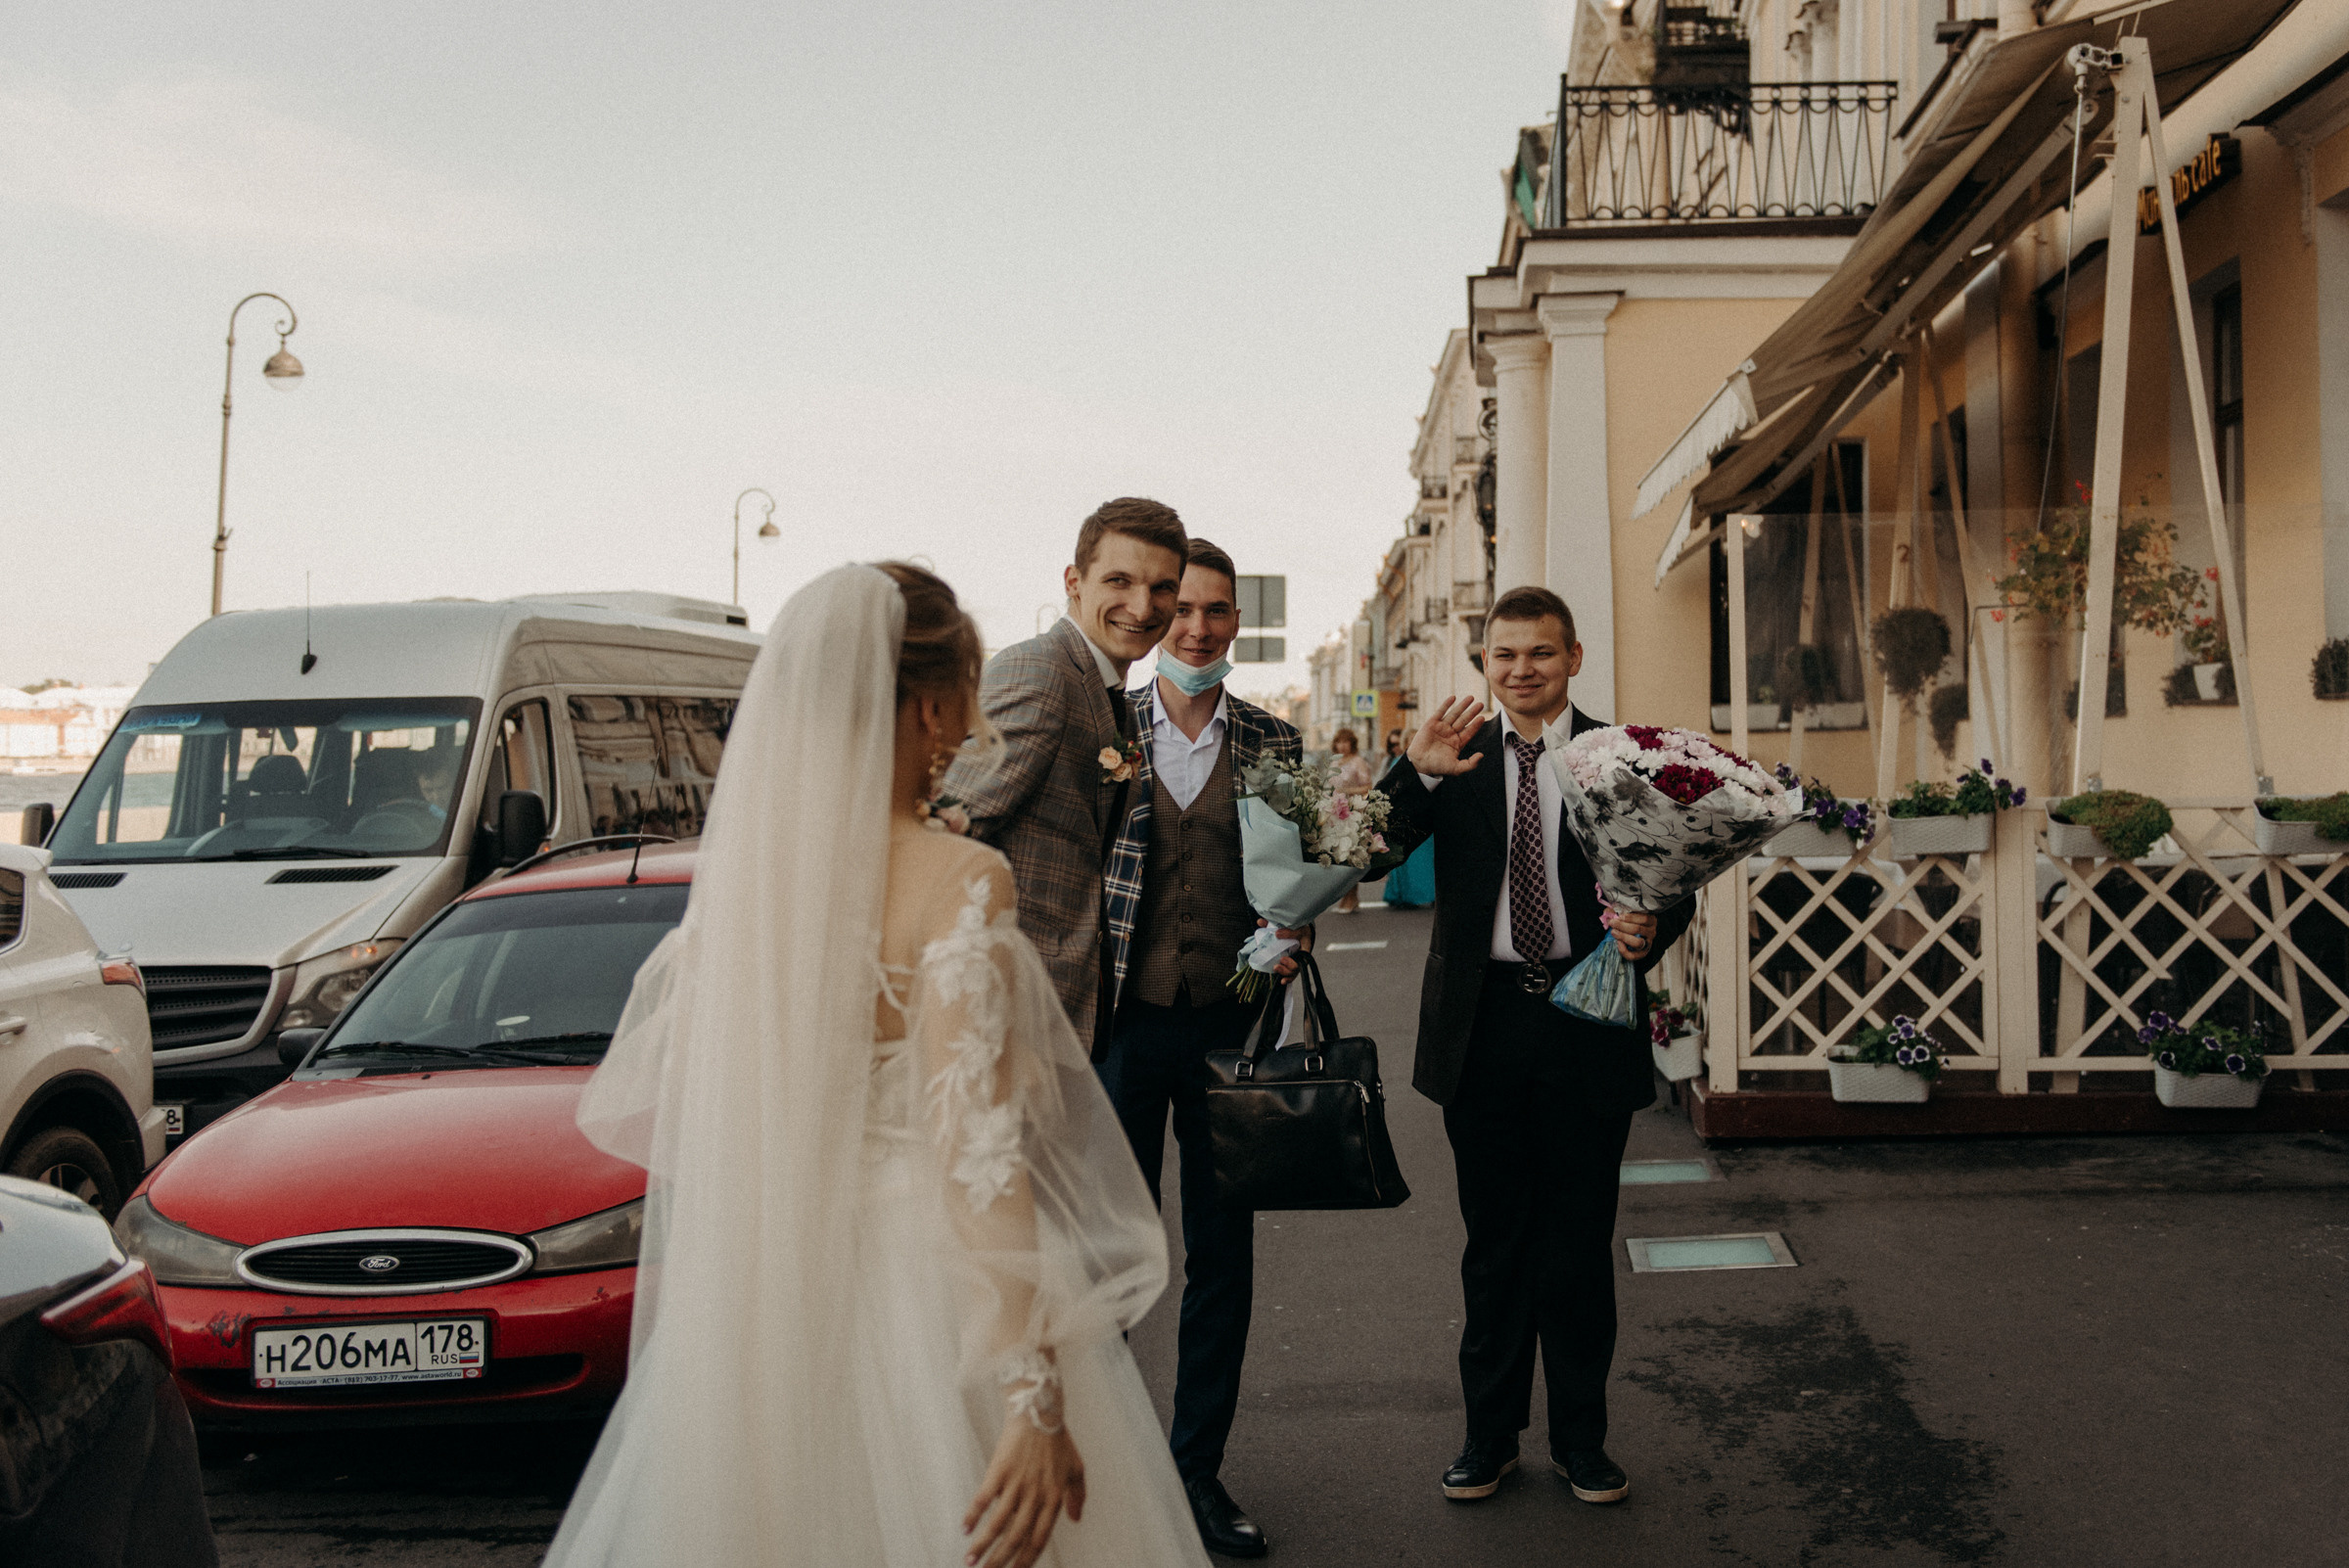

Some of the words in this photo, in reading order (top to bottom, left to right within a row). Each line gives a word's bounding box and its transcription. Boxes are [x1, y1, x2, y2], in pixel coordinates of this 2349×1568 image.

[367, 1258, 392, 1268] Ford
[420, 1324, 474, 1354] 178
[431, 1354, 459, 1365] RUS
